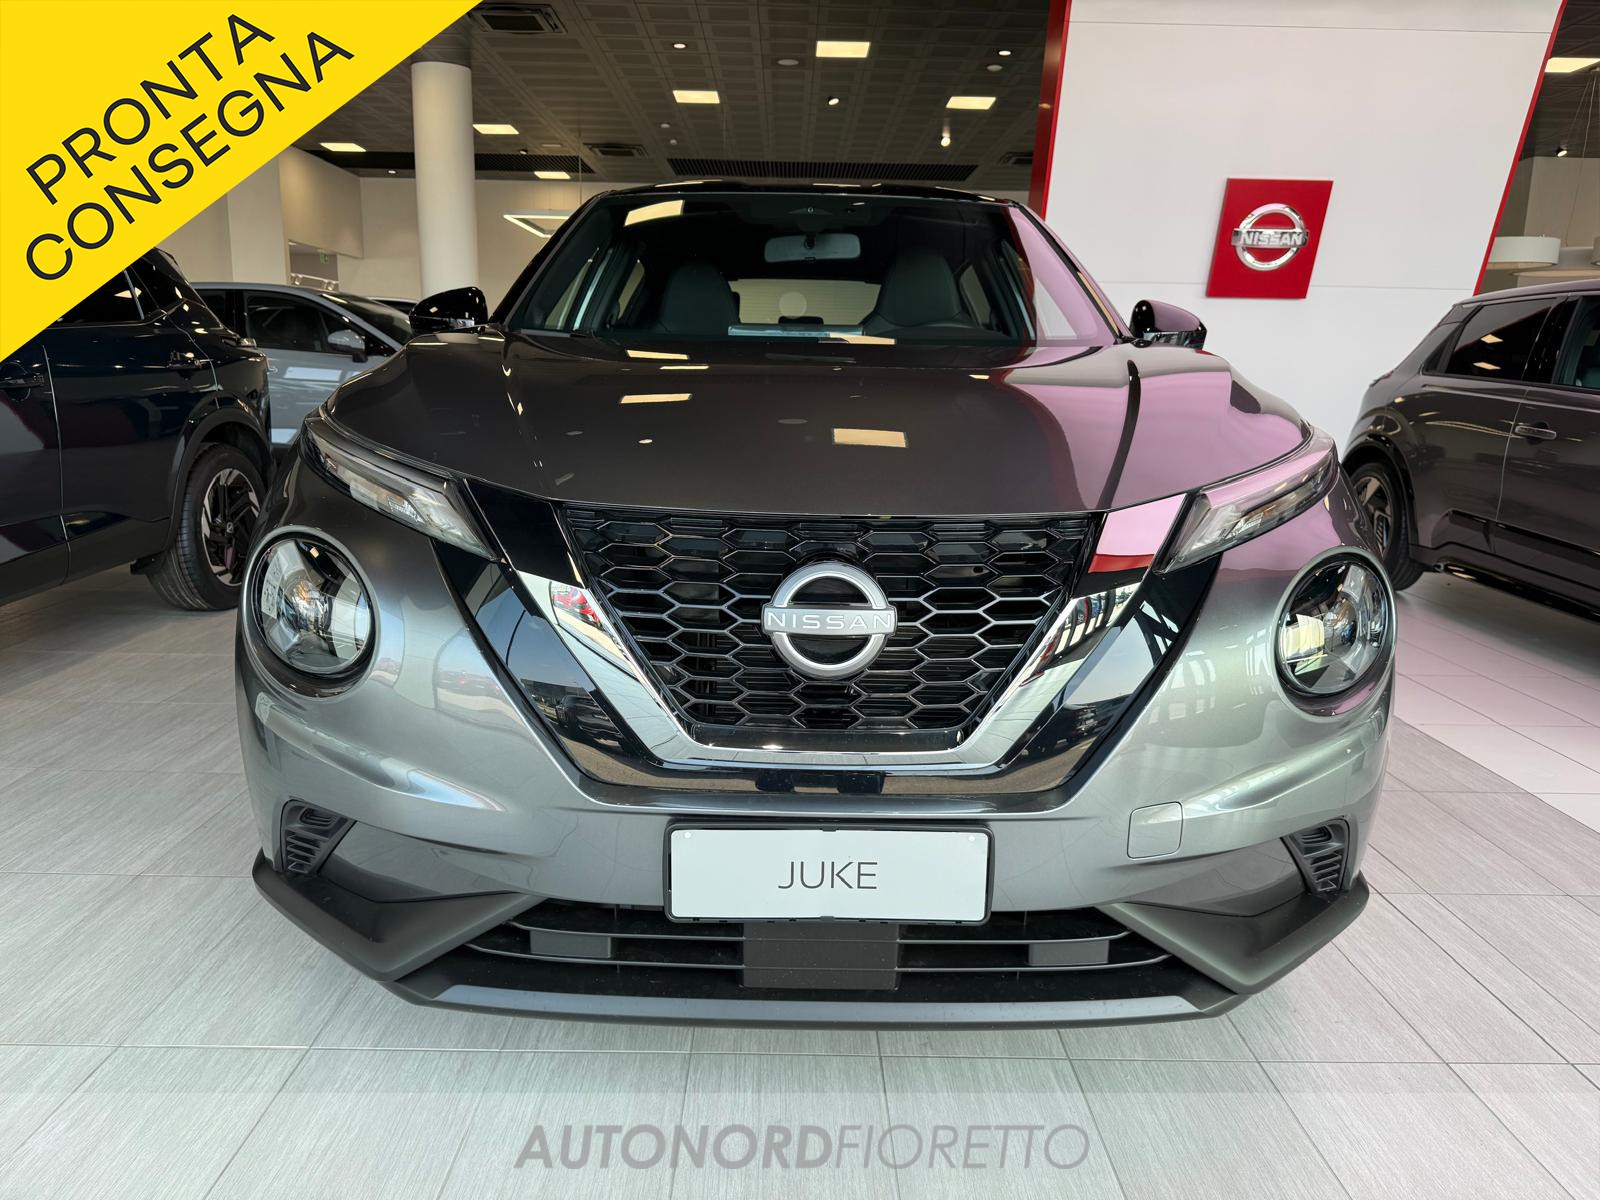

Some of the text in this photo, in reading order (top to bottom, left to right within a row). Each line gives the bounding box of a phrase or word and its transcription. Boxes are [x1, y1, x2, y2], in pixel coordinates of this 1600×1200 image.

[1240, 231, 1303, 246] NISSAN
[767, 612, 891, 630] NISSAN
[777, 861, 878, 890] JUKE
